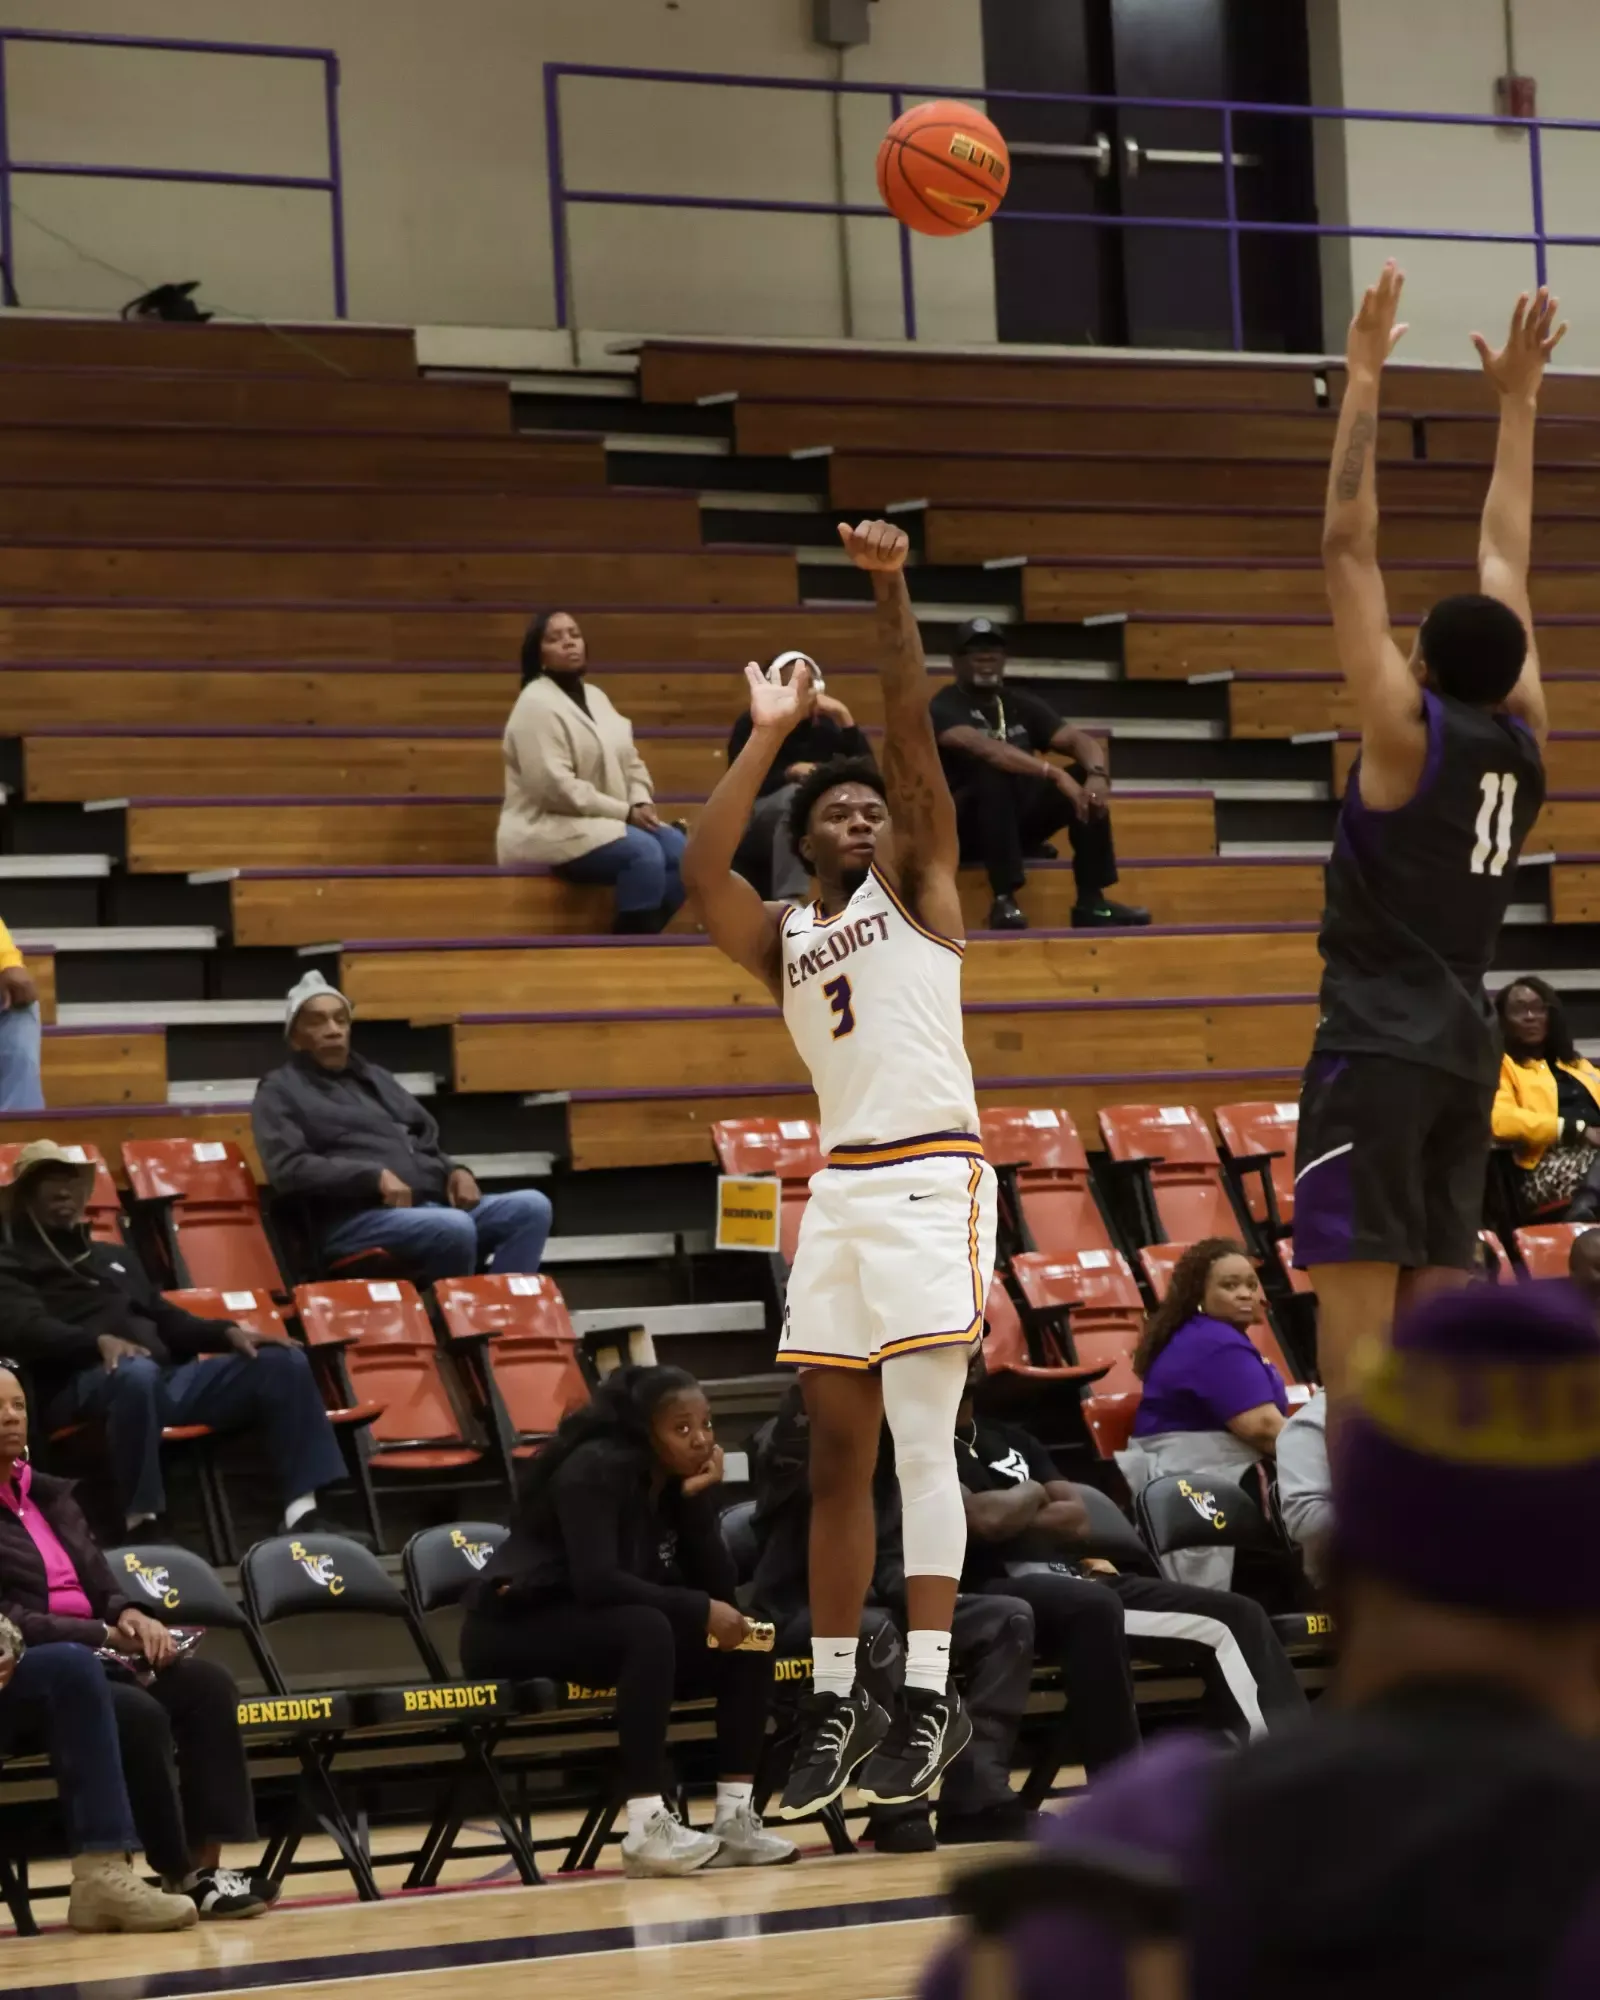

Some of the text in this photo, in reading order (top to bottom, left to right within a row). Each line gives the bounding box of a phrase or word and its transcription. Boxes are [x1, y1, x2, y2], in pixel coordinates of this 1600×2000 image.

[1470, 772, 1518, 876] 11
[821, 972, 856, 1041] 3
[237, 1698, 332, 1724] BENEDICT
[403, 1685, 497, 1711] BENEDICT
